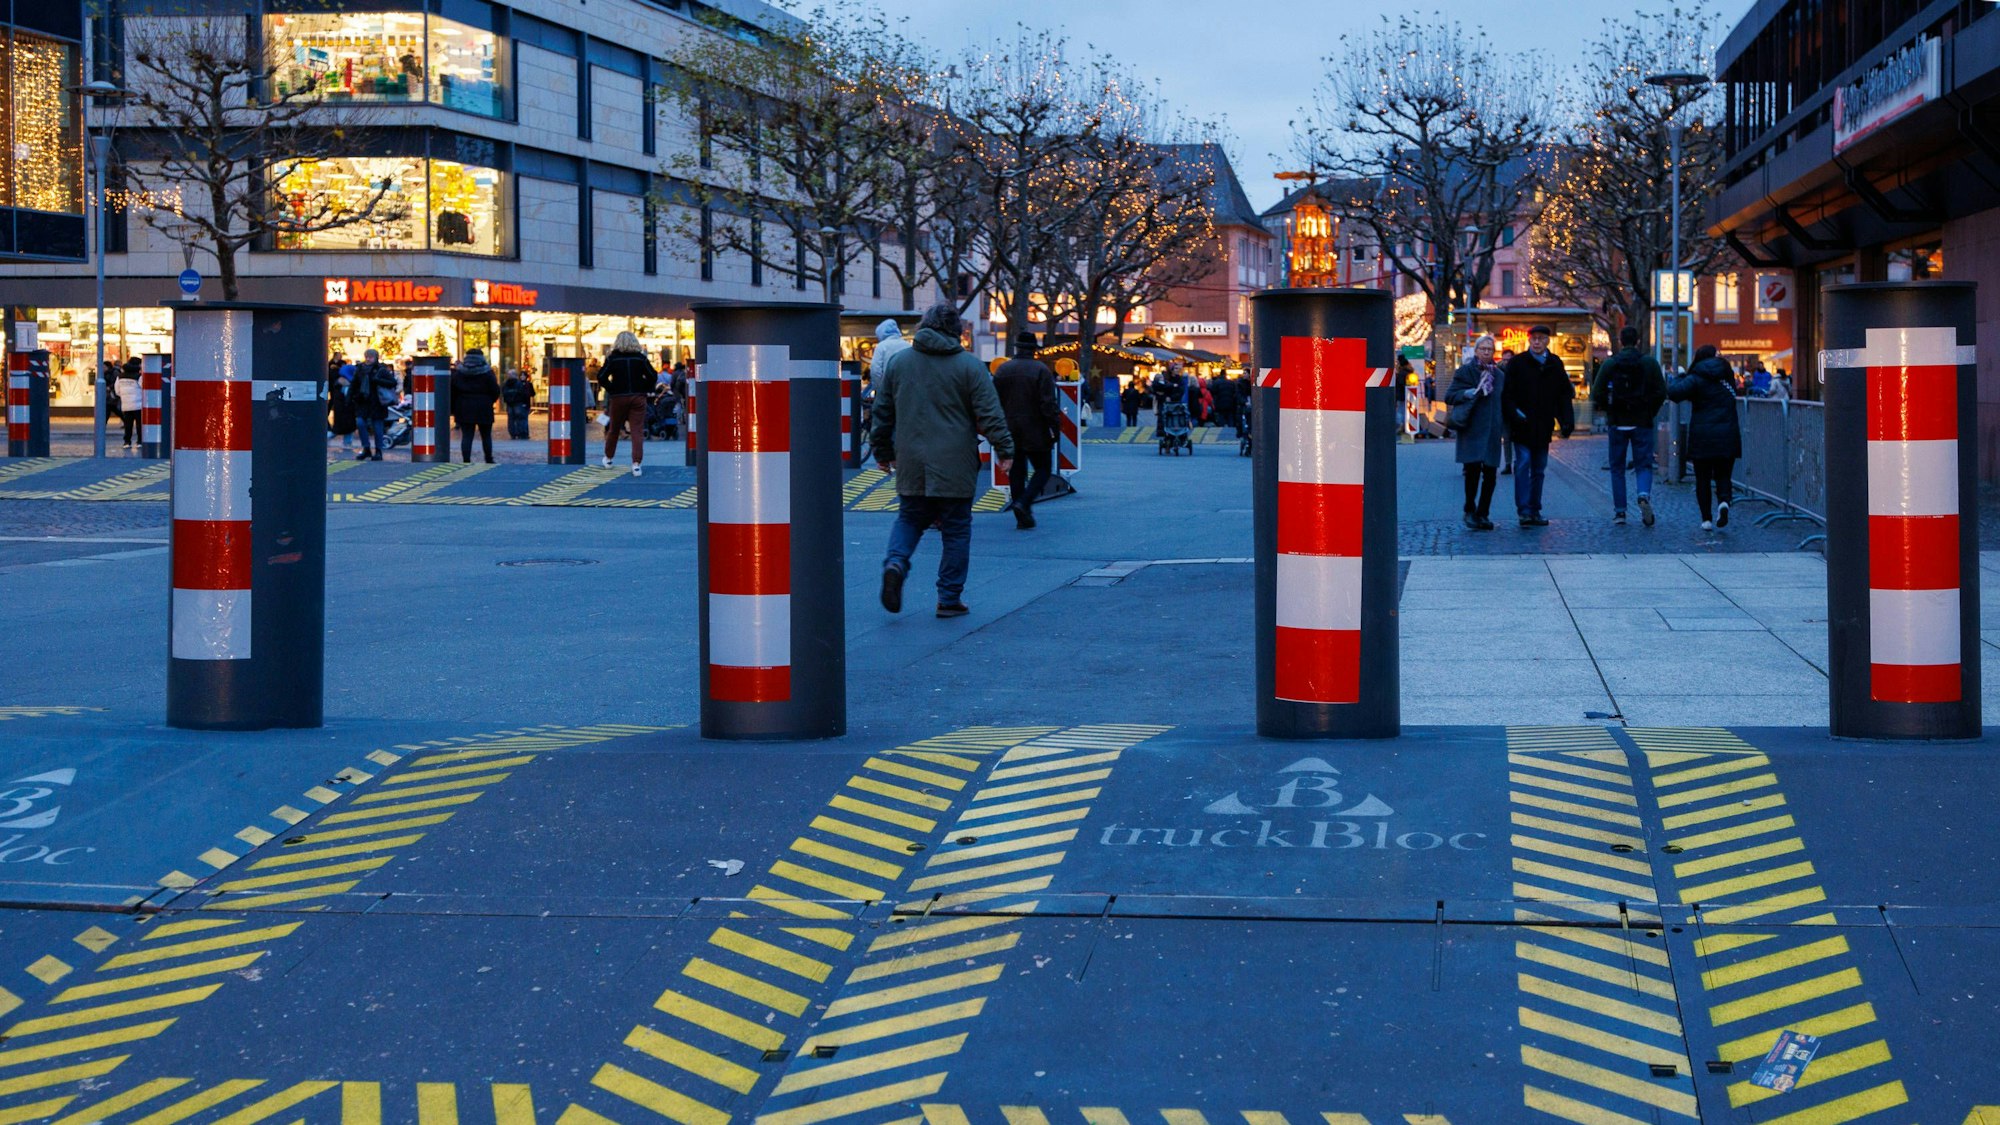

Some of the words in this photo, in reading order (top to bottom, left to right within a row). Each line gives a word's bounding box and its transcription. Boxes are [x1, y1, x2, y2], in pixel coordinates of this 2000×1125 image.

[352, 280, 442, 302] Müller
[489, 283, 538, 305] Müller
[1262, 776, 1343, 808] B
[1100, 820, 1488, 851] truckBloc
